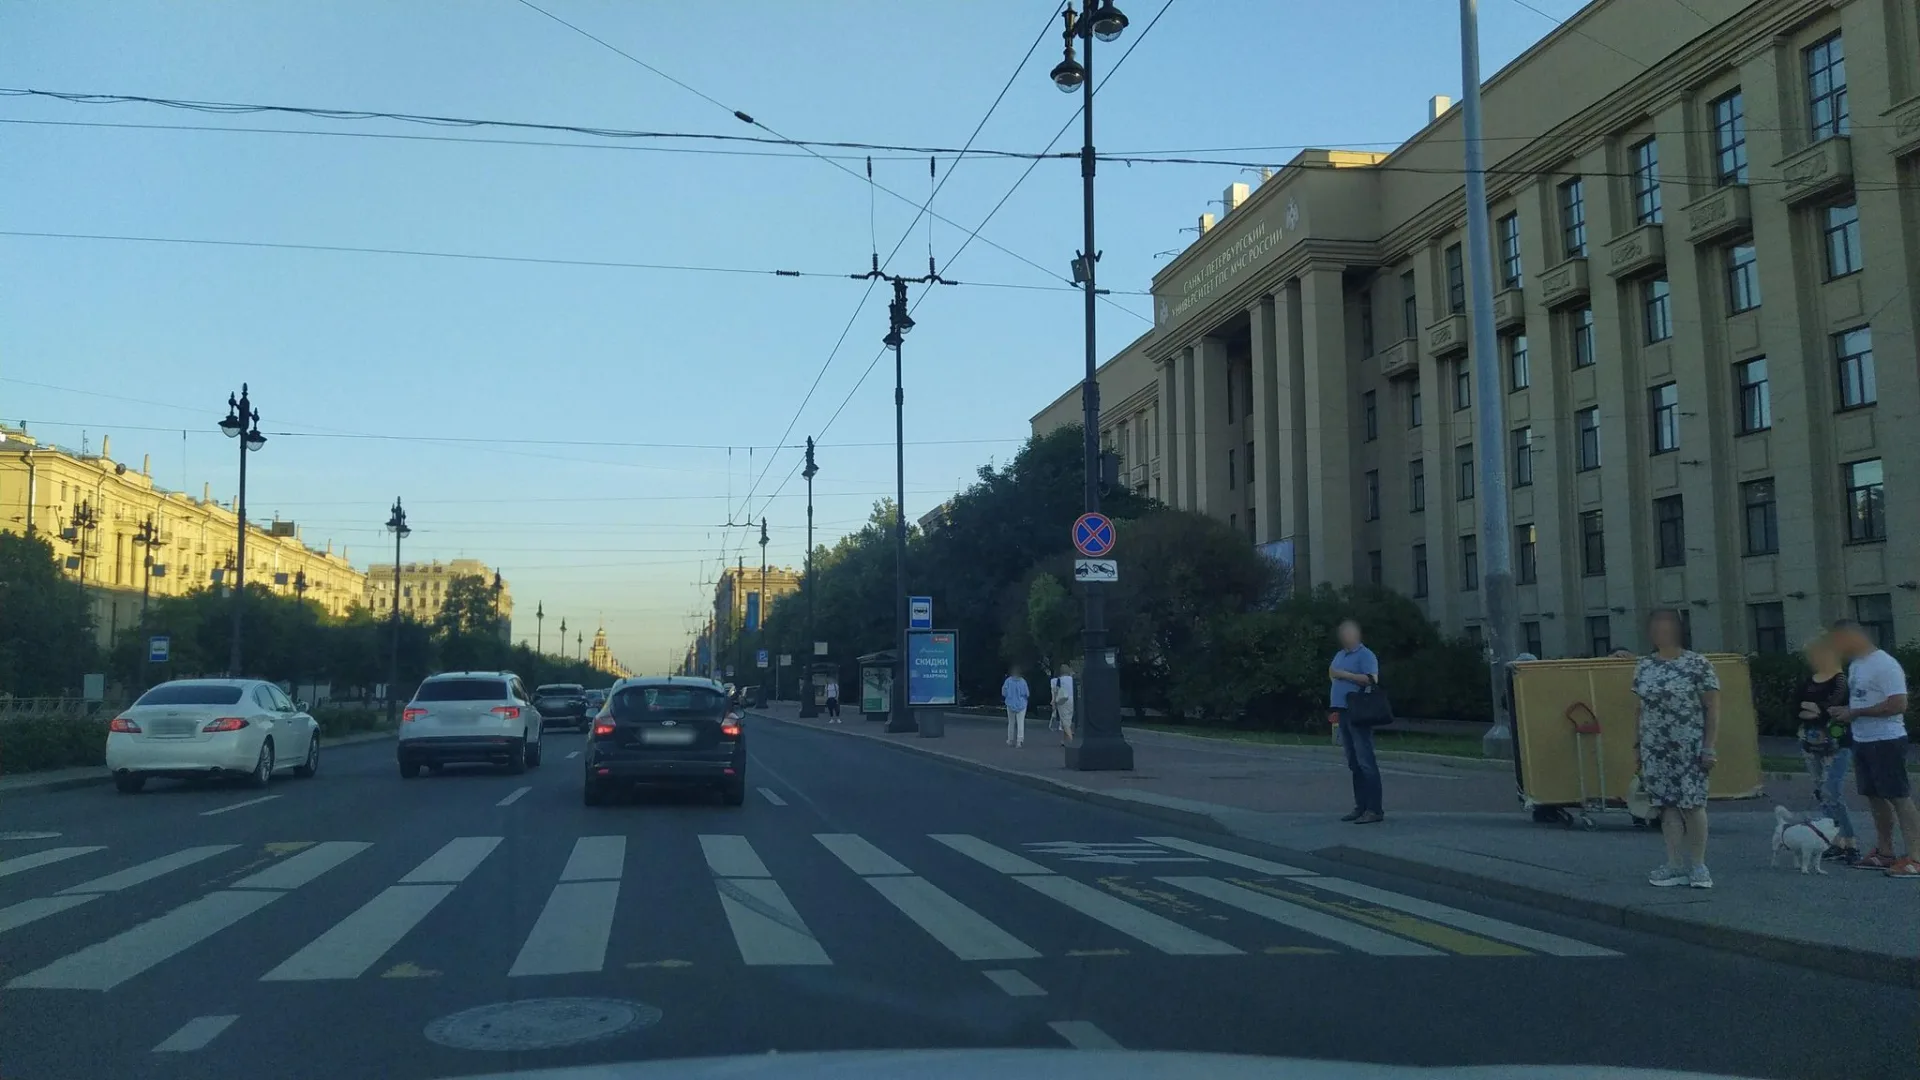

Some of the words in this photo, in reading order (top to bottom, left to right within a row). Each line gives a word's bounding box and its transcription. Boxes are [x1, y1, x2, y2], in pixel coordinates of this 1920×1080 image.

[1171, 280, 1214, 317] УНИВЕРСИТЕТ
[1215, 267, 1229, 288] ГПС
[1231, 253, 1247, 277] МЧС
[1249, 227, 1283, 263] РОССИИ
[1183, 219, 1265, 294] САНКТ-ПЕТЕРБУРГСКИЙ
[915, 658, 948, 667] СКИДКИ
